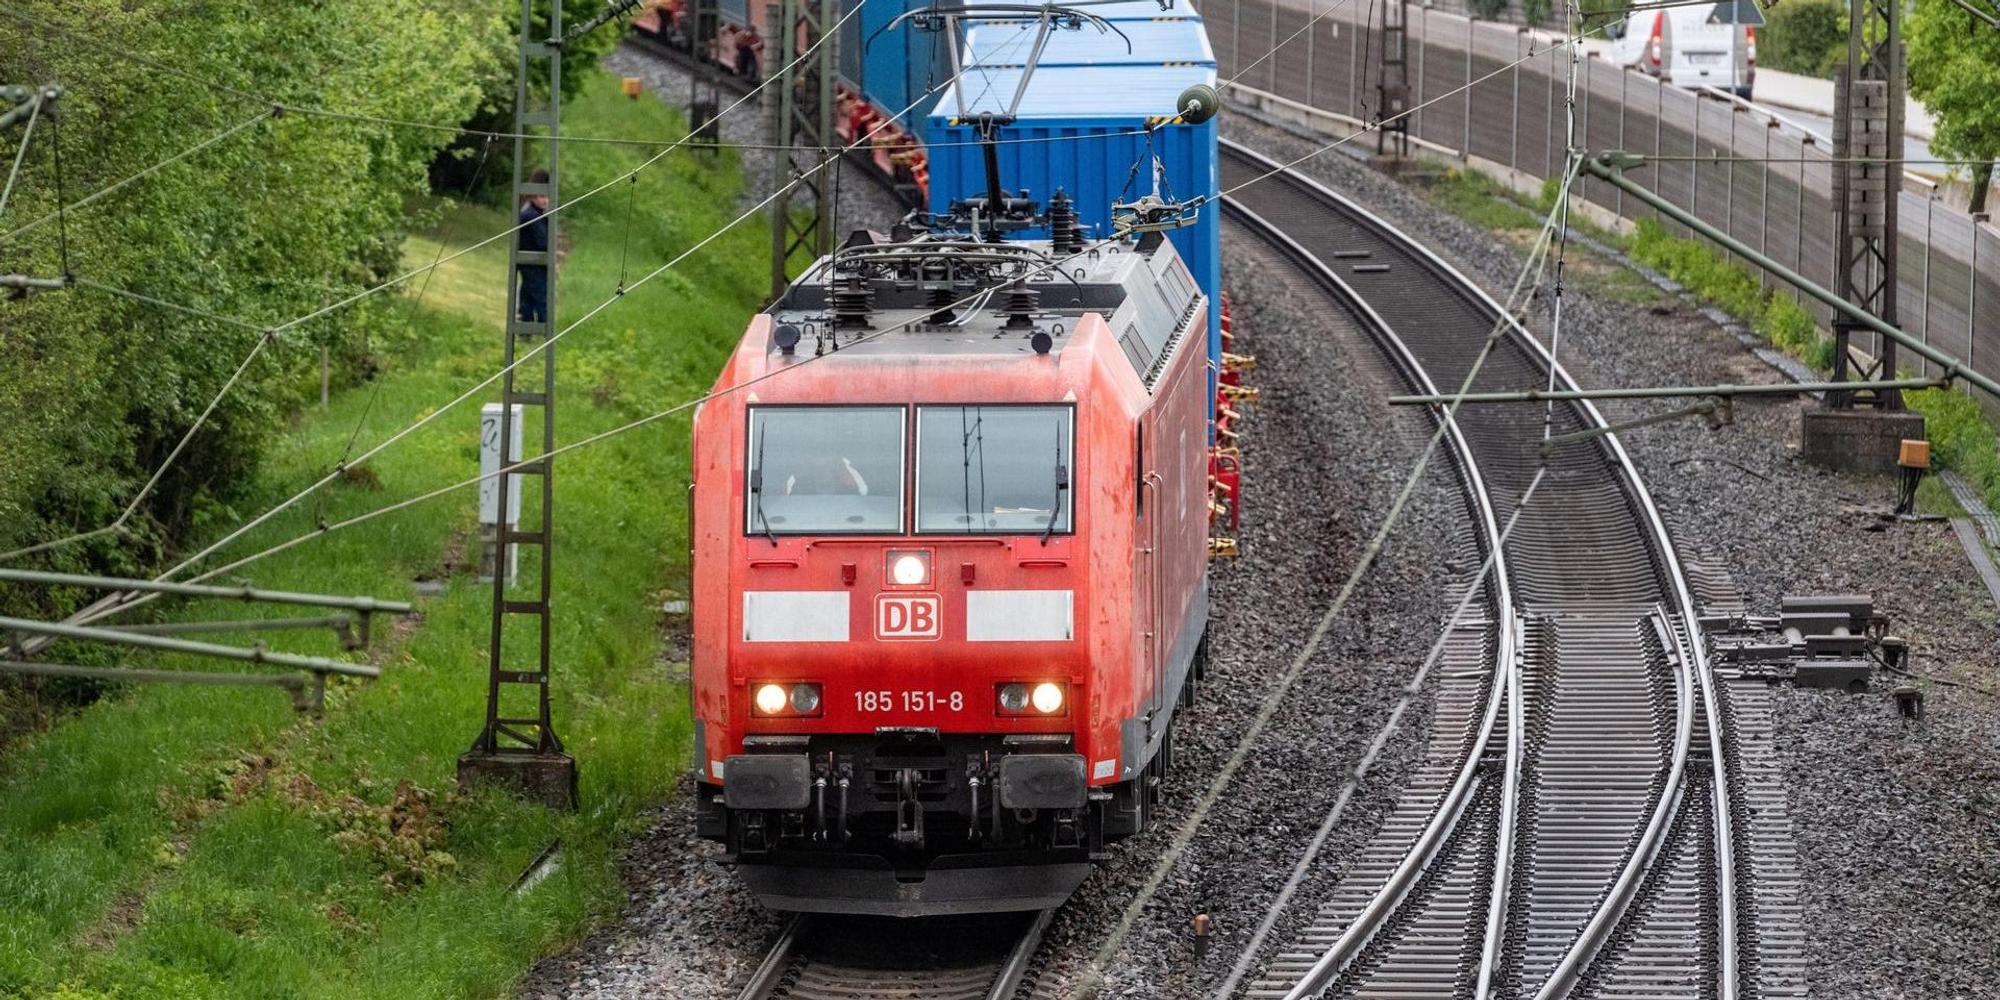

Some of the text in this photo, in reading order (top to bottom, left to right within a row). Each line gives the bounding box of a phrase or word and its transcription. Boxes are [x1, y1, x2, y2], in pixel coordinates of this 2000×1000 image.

[884, 601, 934, 633] DB
[854, 690, 964, 712] 185 151-8
